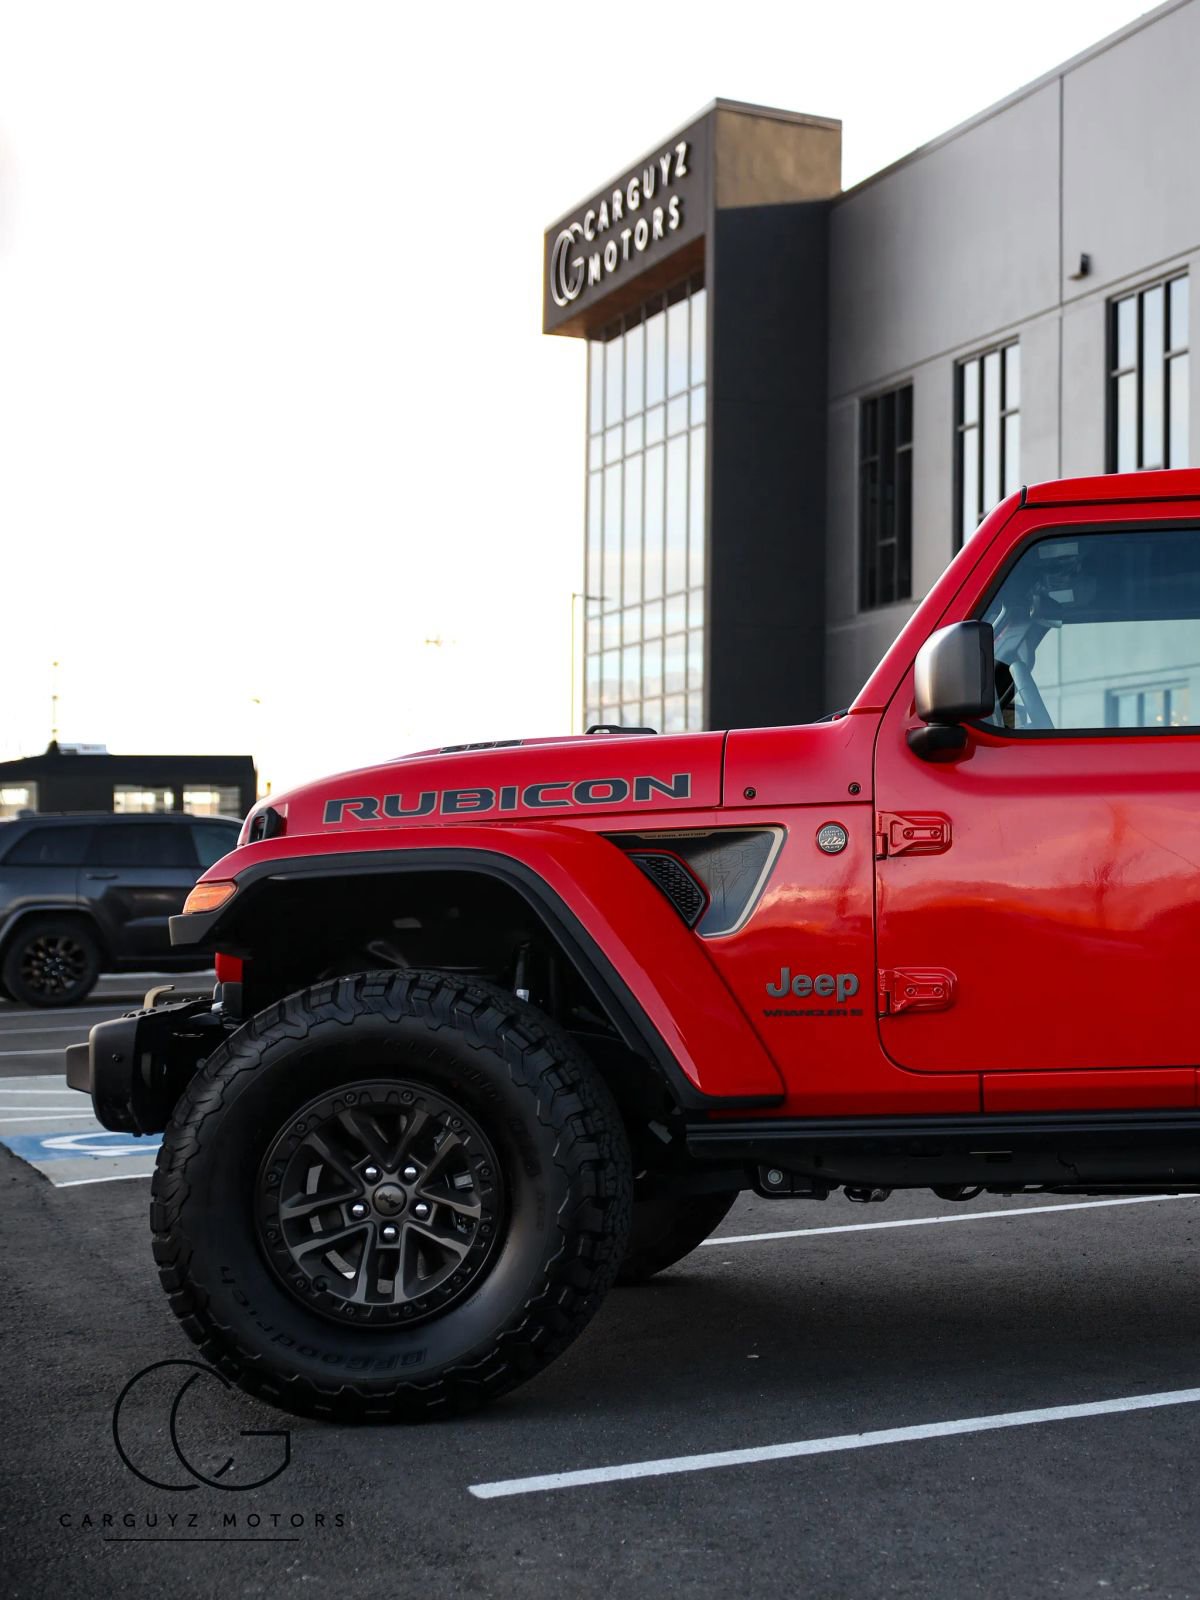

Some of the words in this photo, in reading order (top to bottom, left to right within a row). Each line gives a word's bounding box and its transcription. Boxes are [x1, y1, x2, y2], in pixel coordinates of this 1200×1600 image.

[584, 141, 688, 242] CARGUYZ
[588, 195, 680, 287] MOTORS
[323, 773, 692, 825] RUBICON
[765, 966, 860, 1002] Jeep
